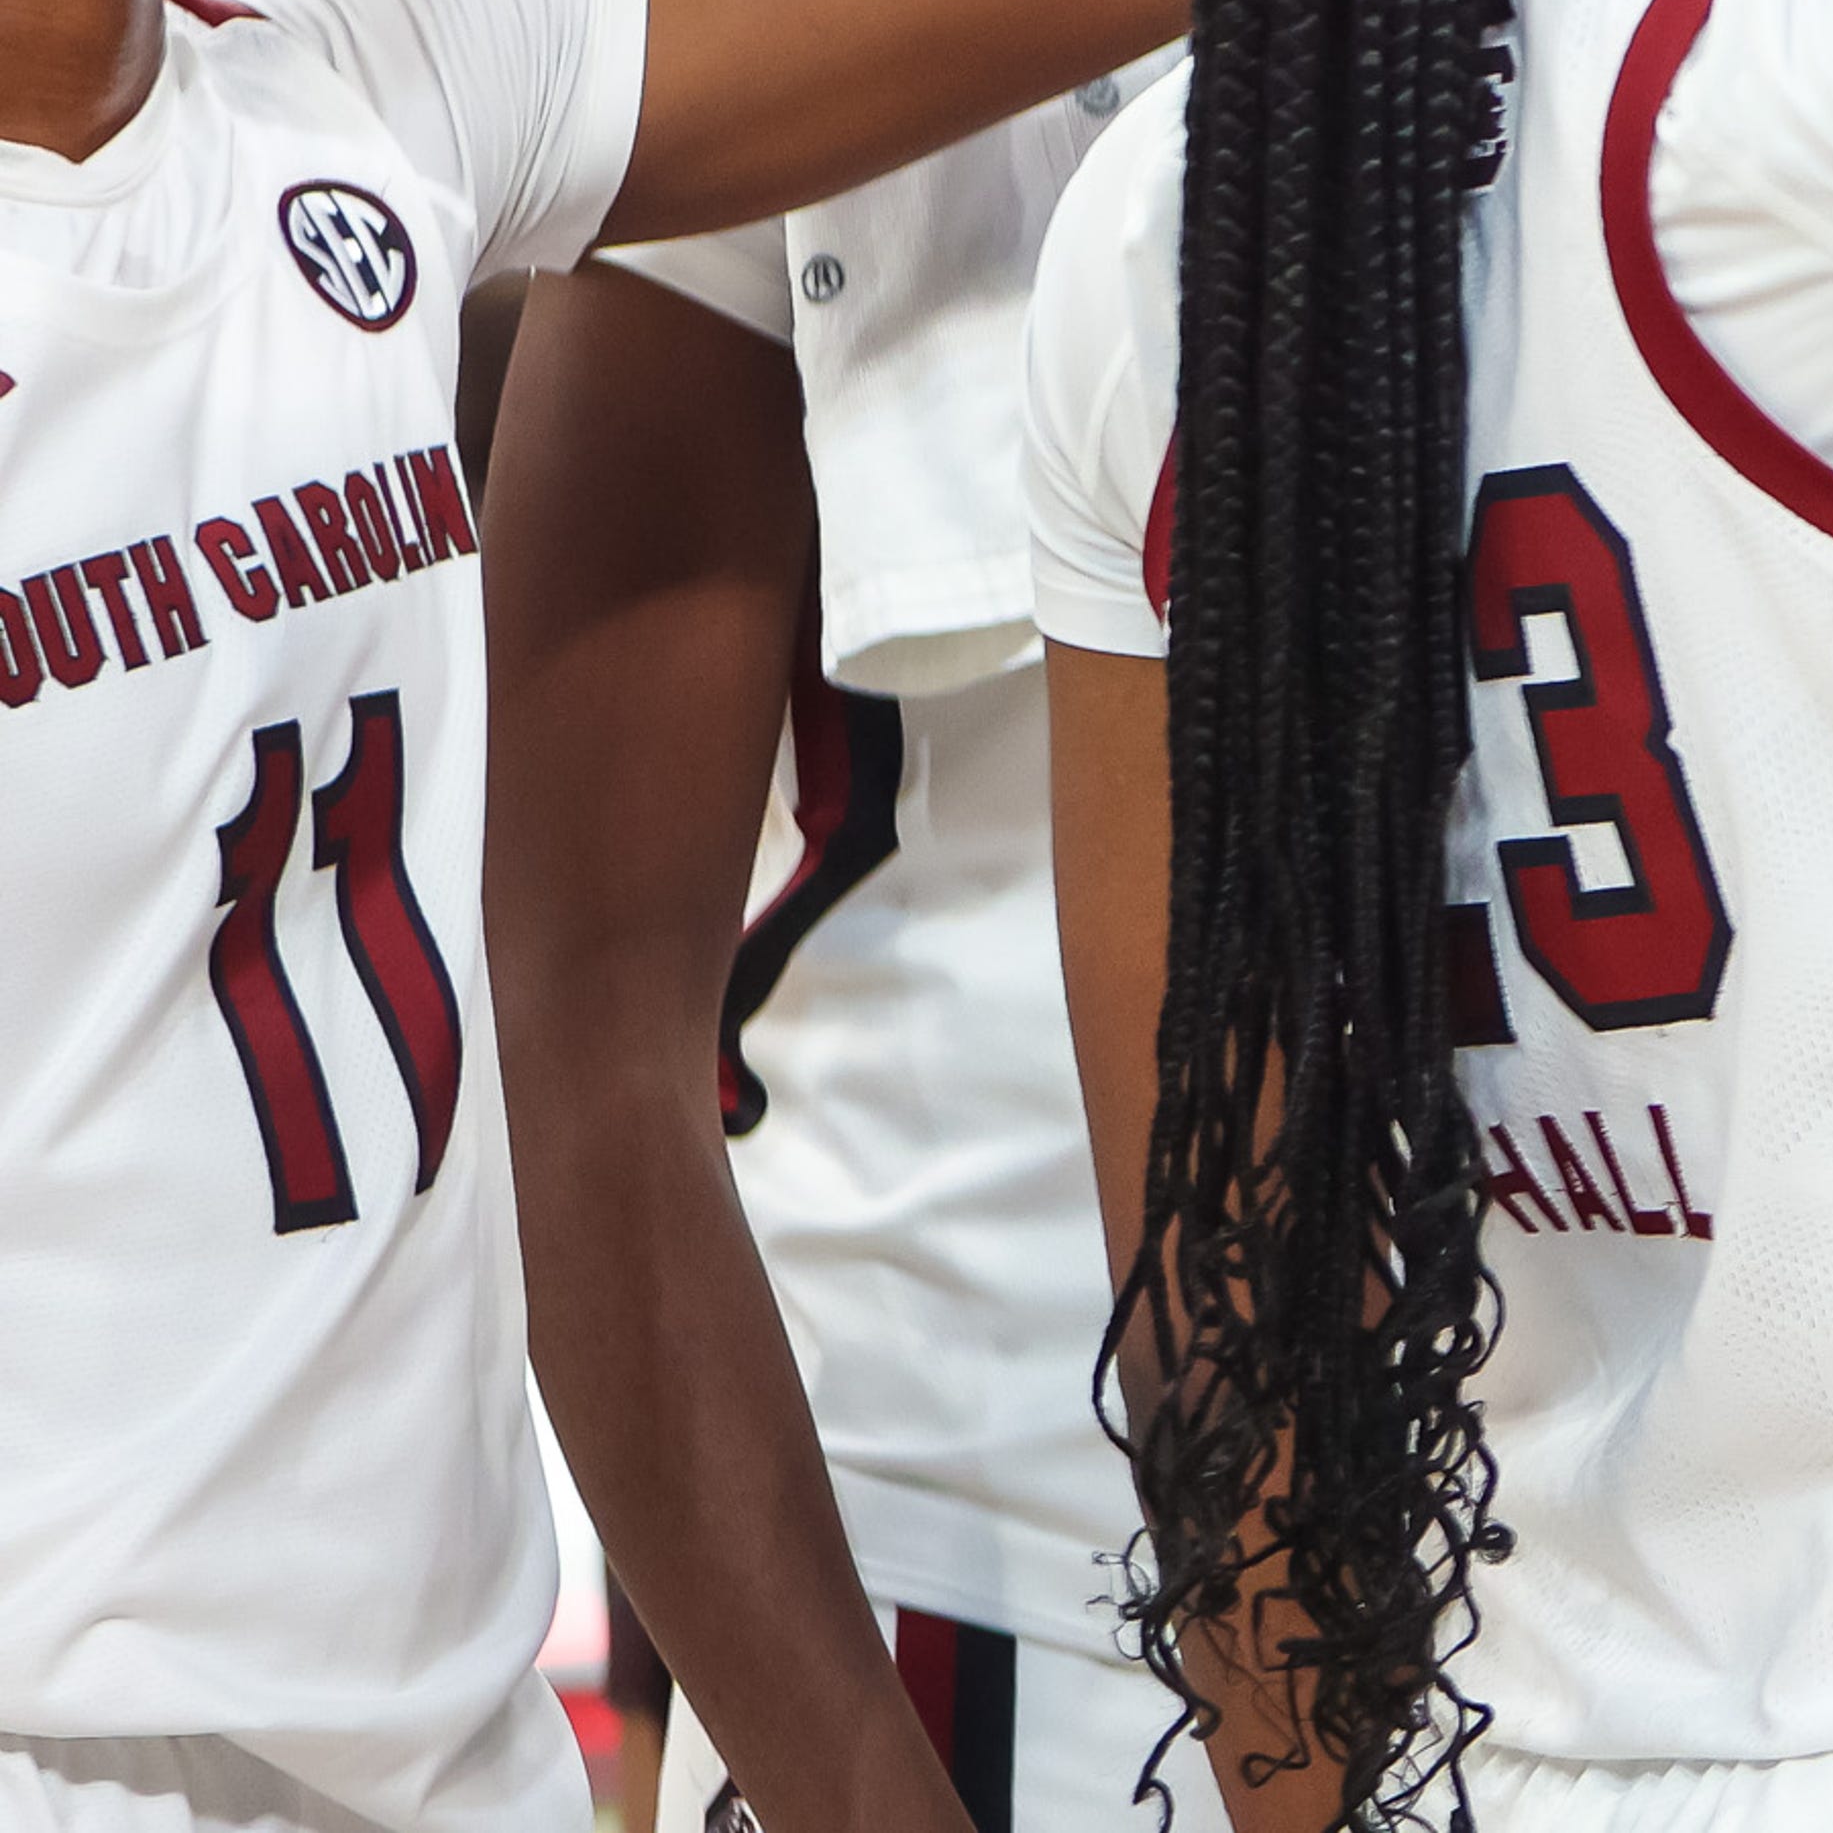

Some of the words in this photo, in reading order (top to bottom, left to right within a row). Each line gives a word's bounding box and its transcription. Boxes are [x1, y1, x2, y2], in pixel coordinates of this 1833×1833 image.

[287, 187, 407, 322] SEC
[0, 534, 211, 709] OUTH
[194, 443, 480, 623] CAROLIN
[1447, 461, 1736, 1048] 3
[207, 686, 463, 1236] 11
